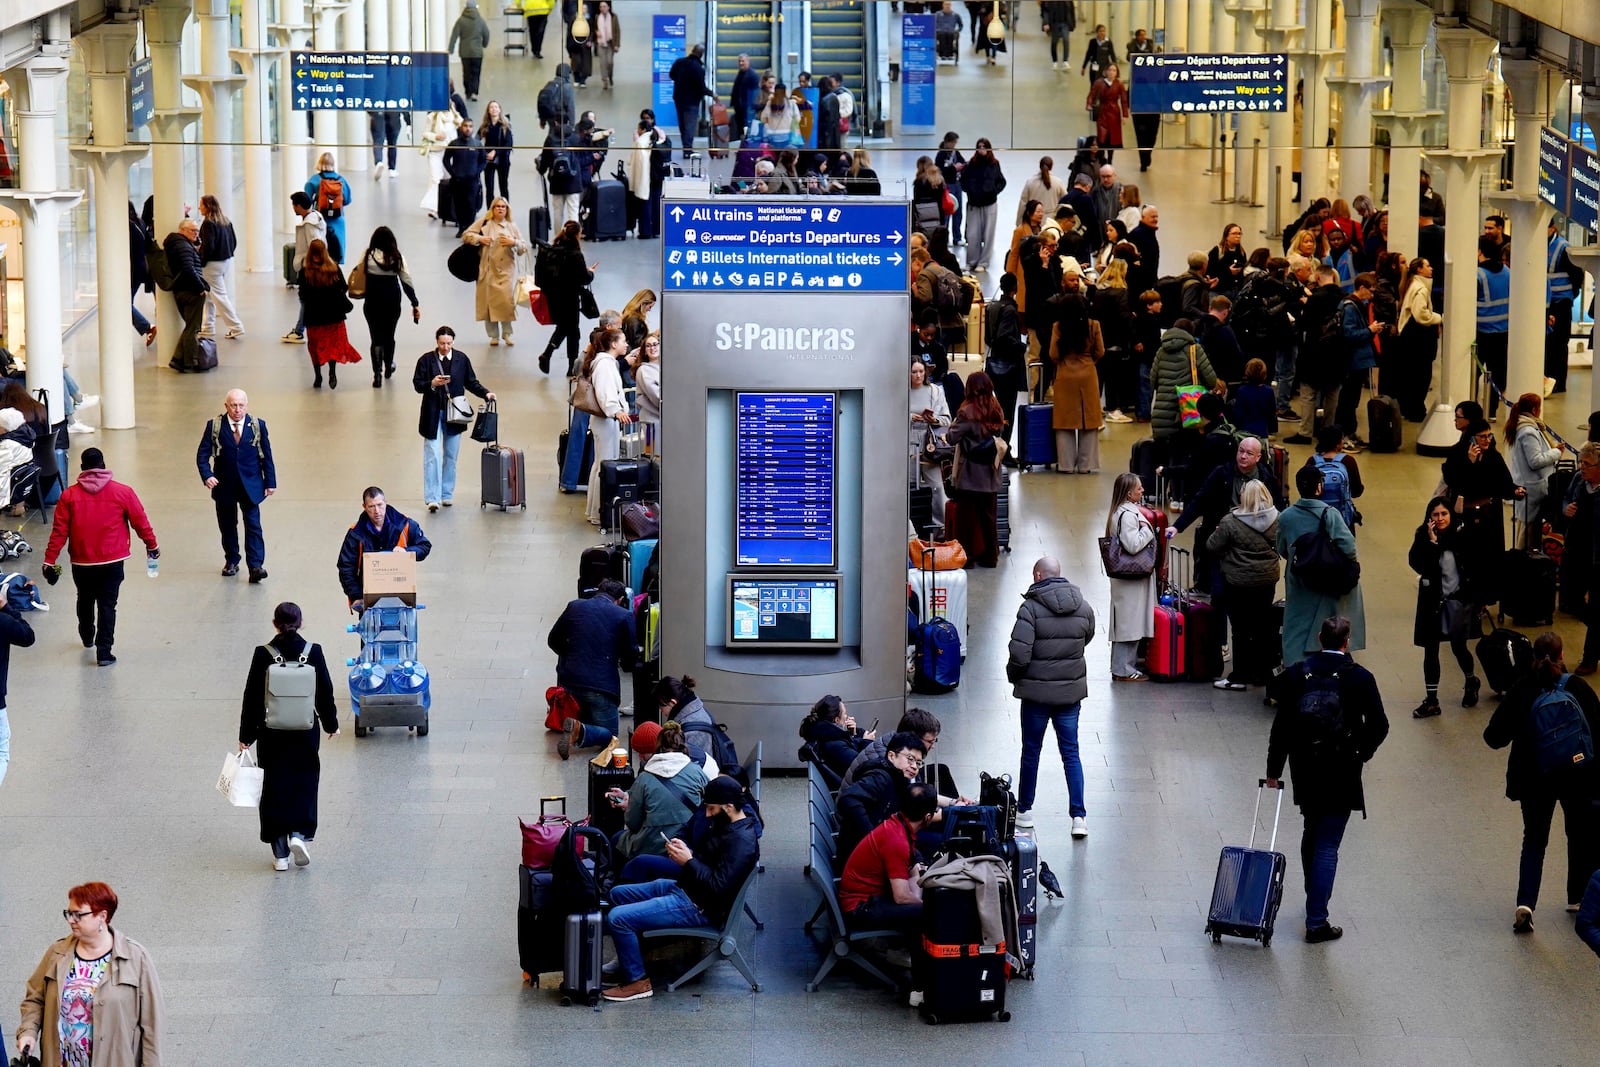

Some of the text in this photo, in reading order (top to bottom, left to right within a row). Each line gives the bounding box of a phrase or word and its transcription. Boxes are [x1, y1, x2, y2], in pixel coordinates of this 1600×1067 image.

[310, 55, 364, 65] National Rail
[1187, 55, 1220, 66] Départs
[1222, 55, 1270, 66] Departures
[311, 70, 344, 79] Way out
[1215, 70, 1270, 80] National Rail
[311, 84, 333, 93] Taxis
[1236, 85, 1270, 96] Way out
[692, 208, 753, 221] All trains
[757, 206, 784, 214] National
[770, 215, 802, 223] platforms
[750, 230, 802, 246] Départs
[805, 230, 881, 246] Departures
[701, 251, 881, 265] Billets International tickets
[778, 271, 787, 286] P
[715, 322, 856, 350] St Pancras
